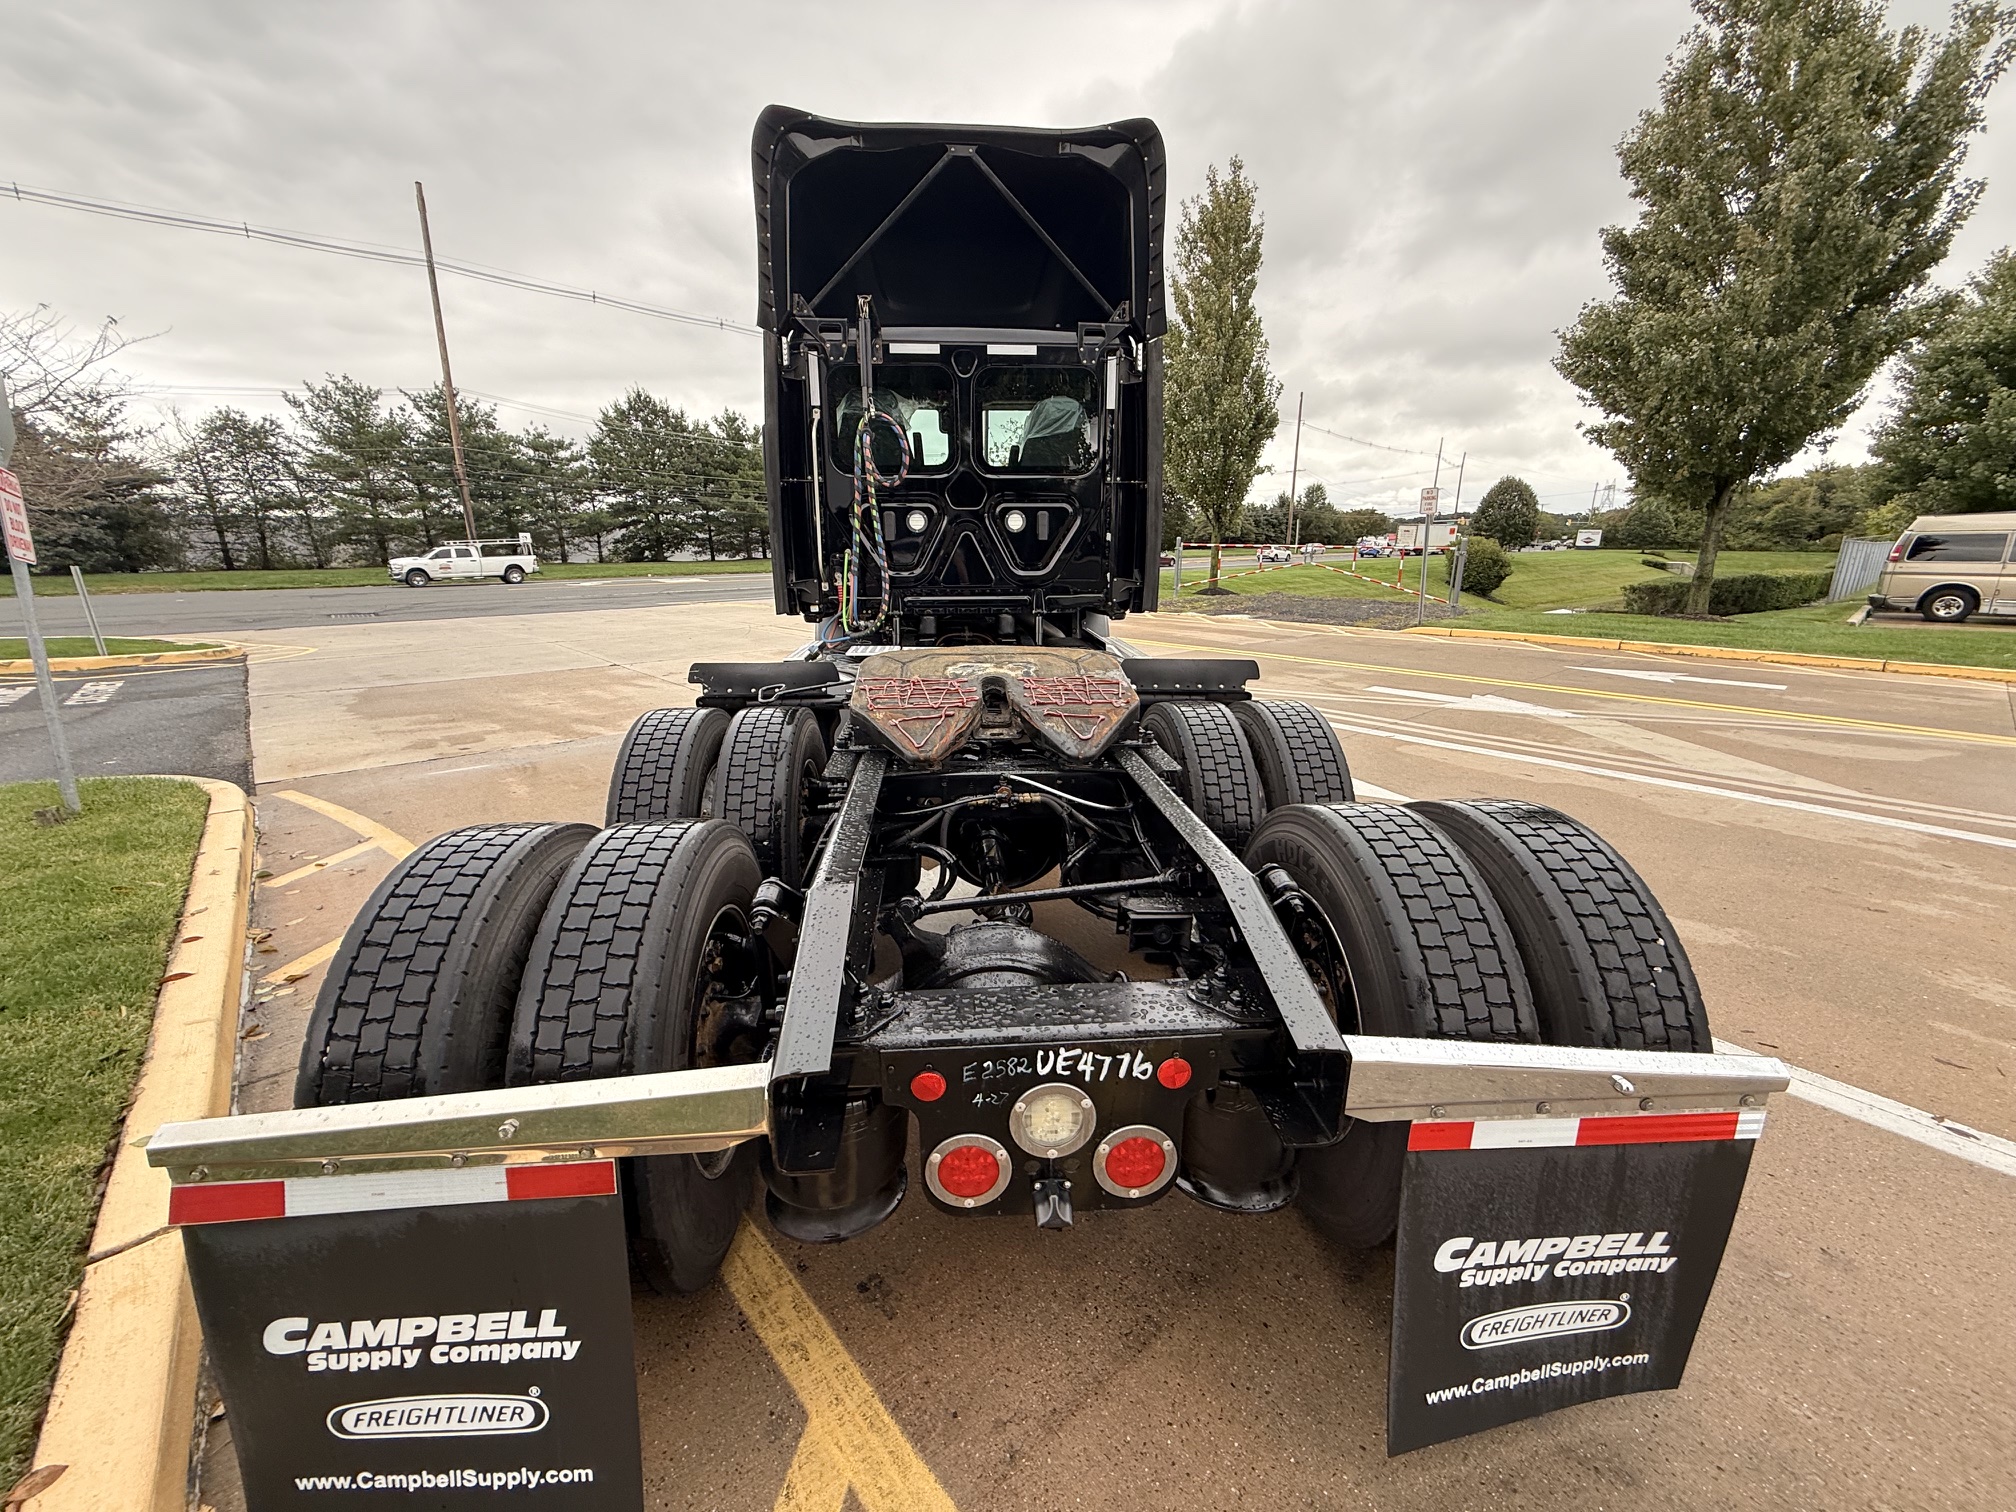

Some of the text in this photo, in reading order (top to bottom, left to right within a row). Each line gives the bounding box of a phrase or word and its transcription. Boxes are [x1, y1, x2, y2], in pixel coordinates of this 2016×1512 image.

[9, 517, 26, 534] BLOCK
[1459, 1263, 1549, 1288] Supply
[1478, 1308, 1612, 1339] FREIGHTLINER
[308, 1347, 422, 1372] Supply
[1426, 1352, 1649, 1405] www.CampbellSupply.com
[353, 1405, 525, 1428] FREIGHTLINER
[295, 1467, 594, 1492] www.CampbellSupply.com
